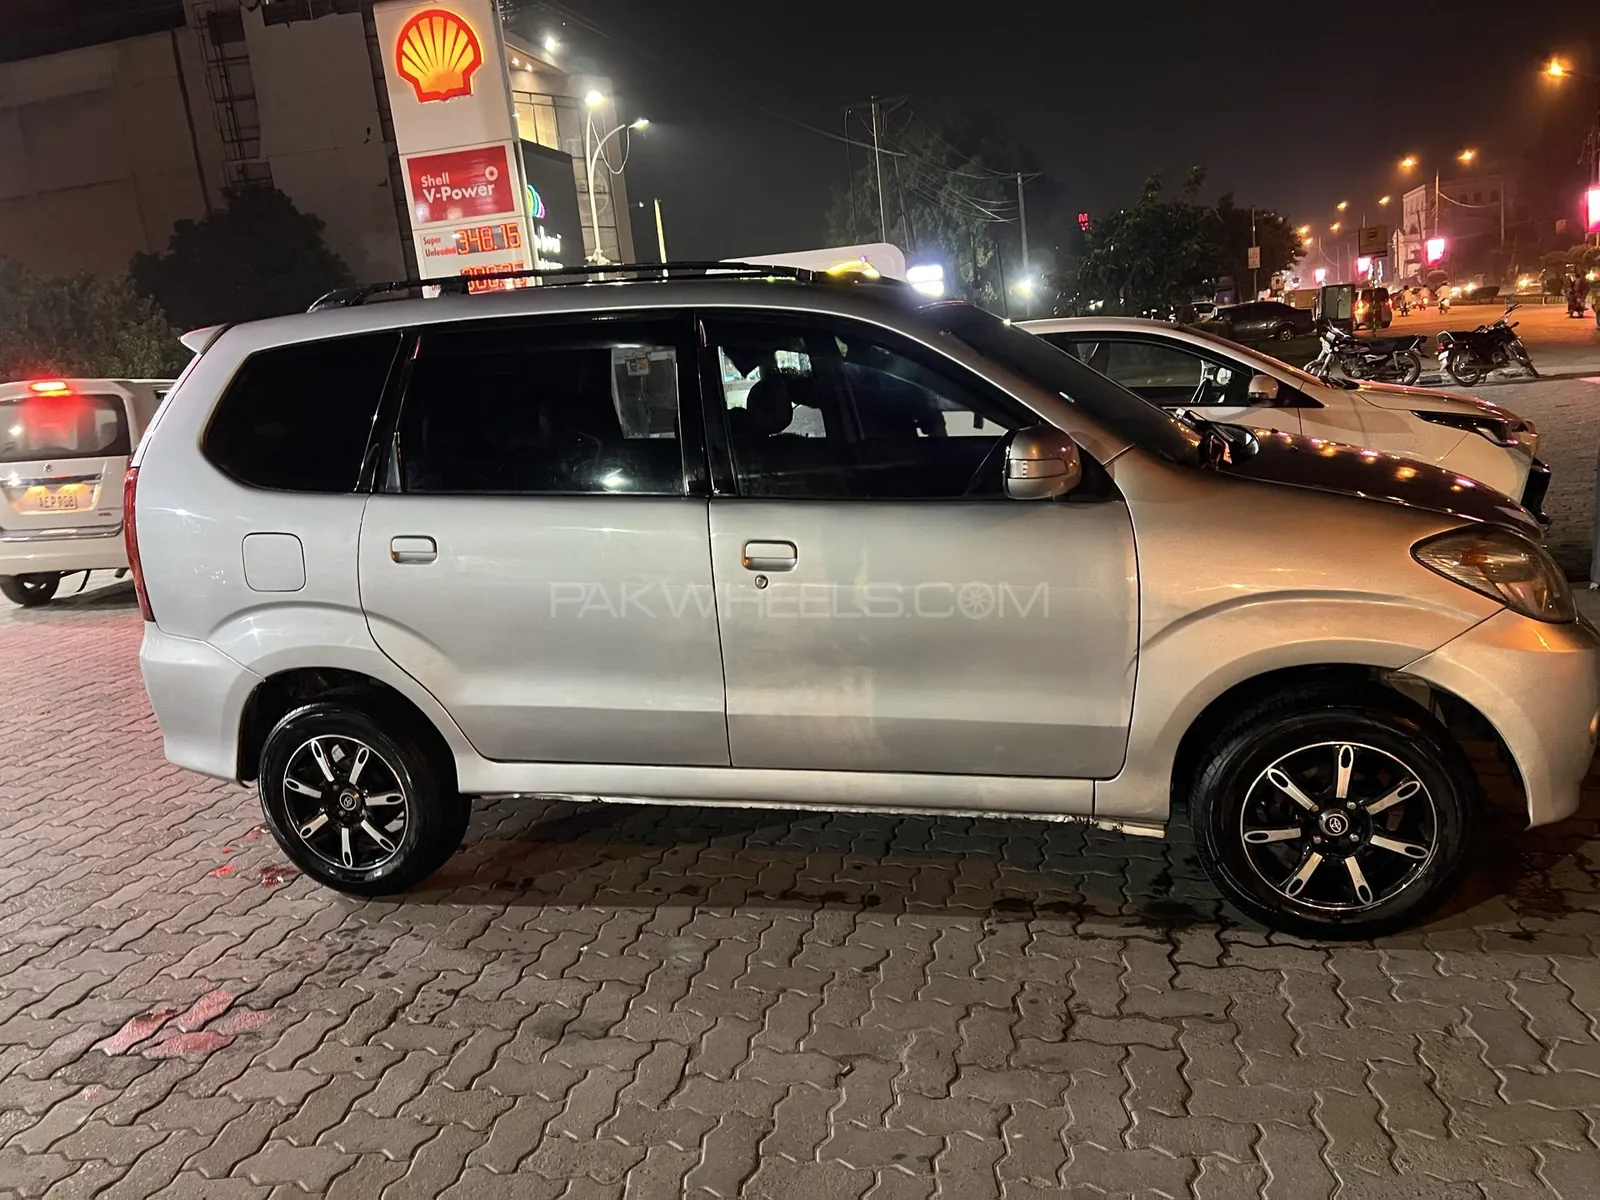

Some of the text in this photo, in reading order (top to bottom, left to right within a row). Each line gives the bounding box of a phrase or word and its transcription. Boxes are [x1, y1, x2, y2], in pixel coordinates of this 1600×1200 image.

[421, 172, 450, 187] Shell
[422, 184, 495, 204] V-Power
[423, 237, 441, 247] Super
[457, 222, 521, 255] 348.15
